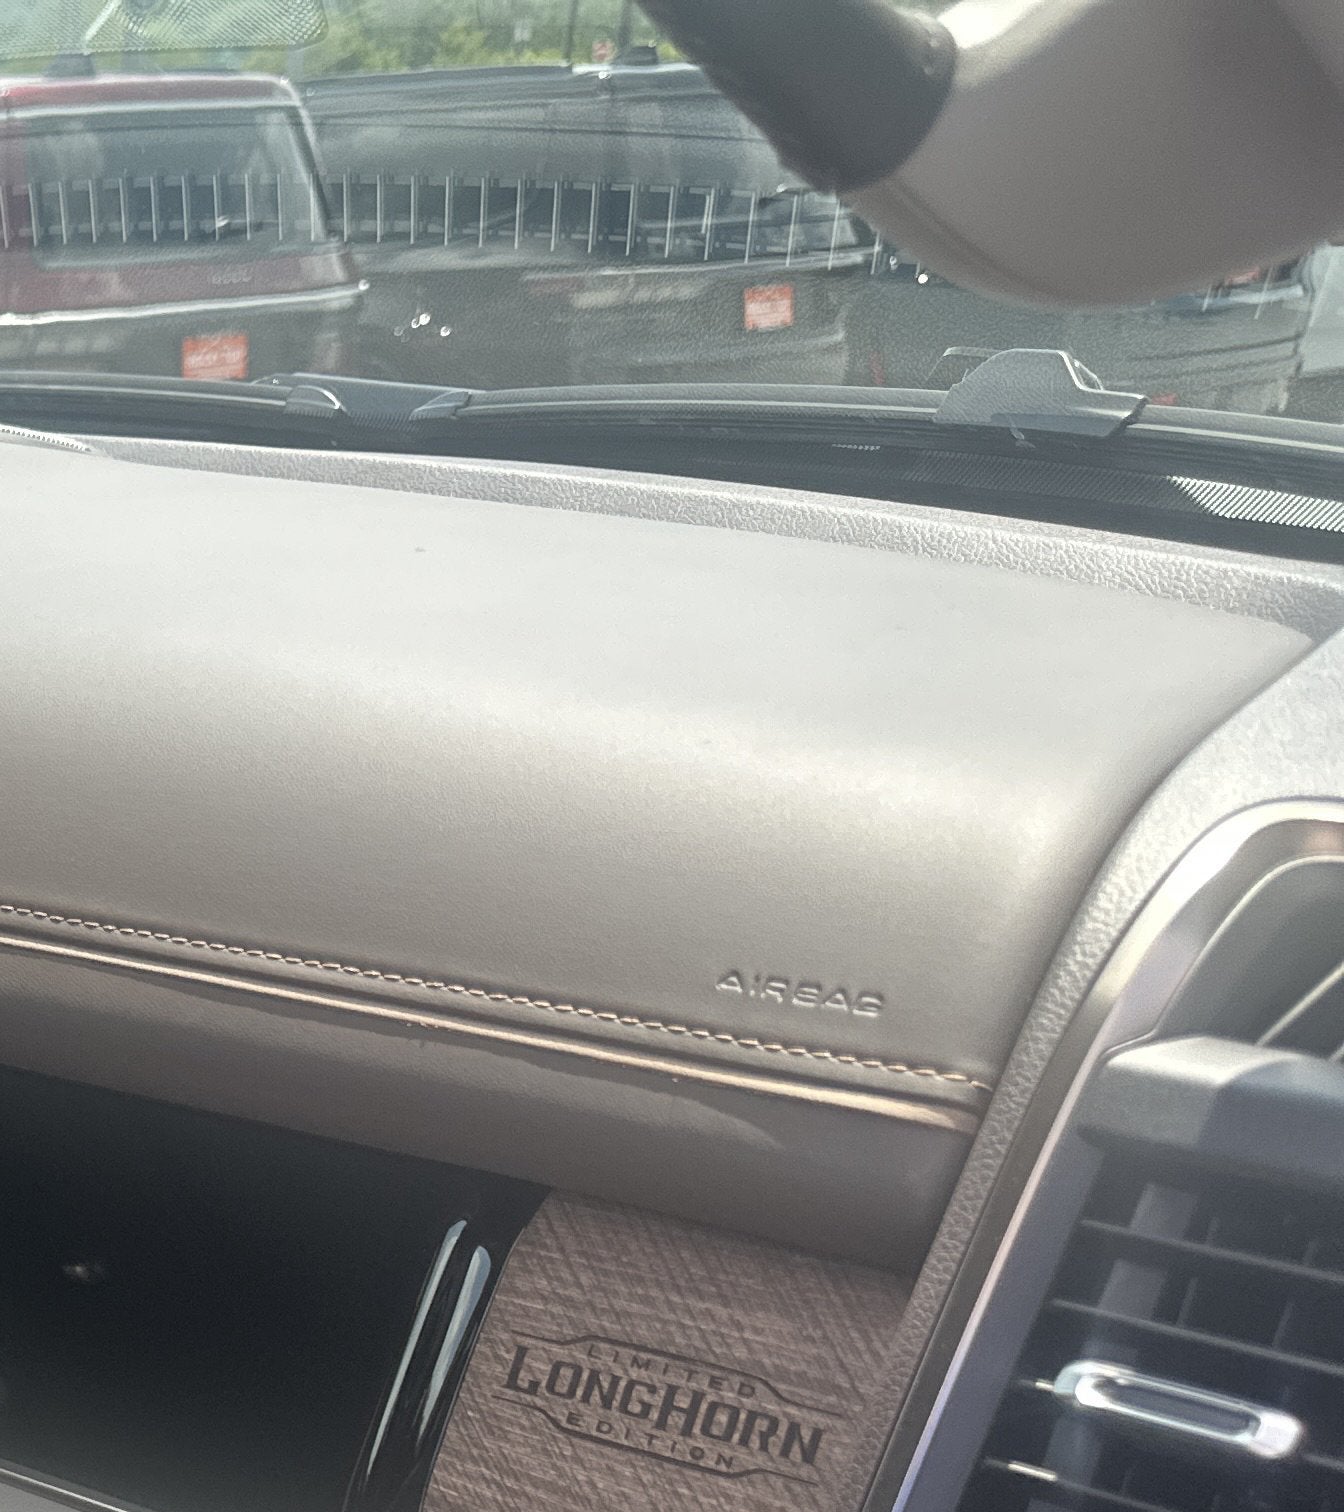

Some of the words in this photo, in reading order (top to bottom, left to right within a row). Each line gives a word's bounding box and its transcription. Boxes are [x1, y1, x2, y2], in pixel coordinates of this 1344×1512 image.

[587, 1345, 756, 1397] LIMITED
[506, 1345, 825, 1465] LONGHORN
[566, 1412, 734, 1469] EDITION
